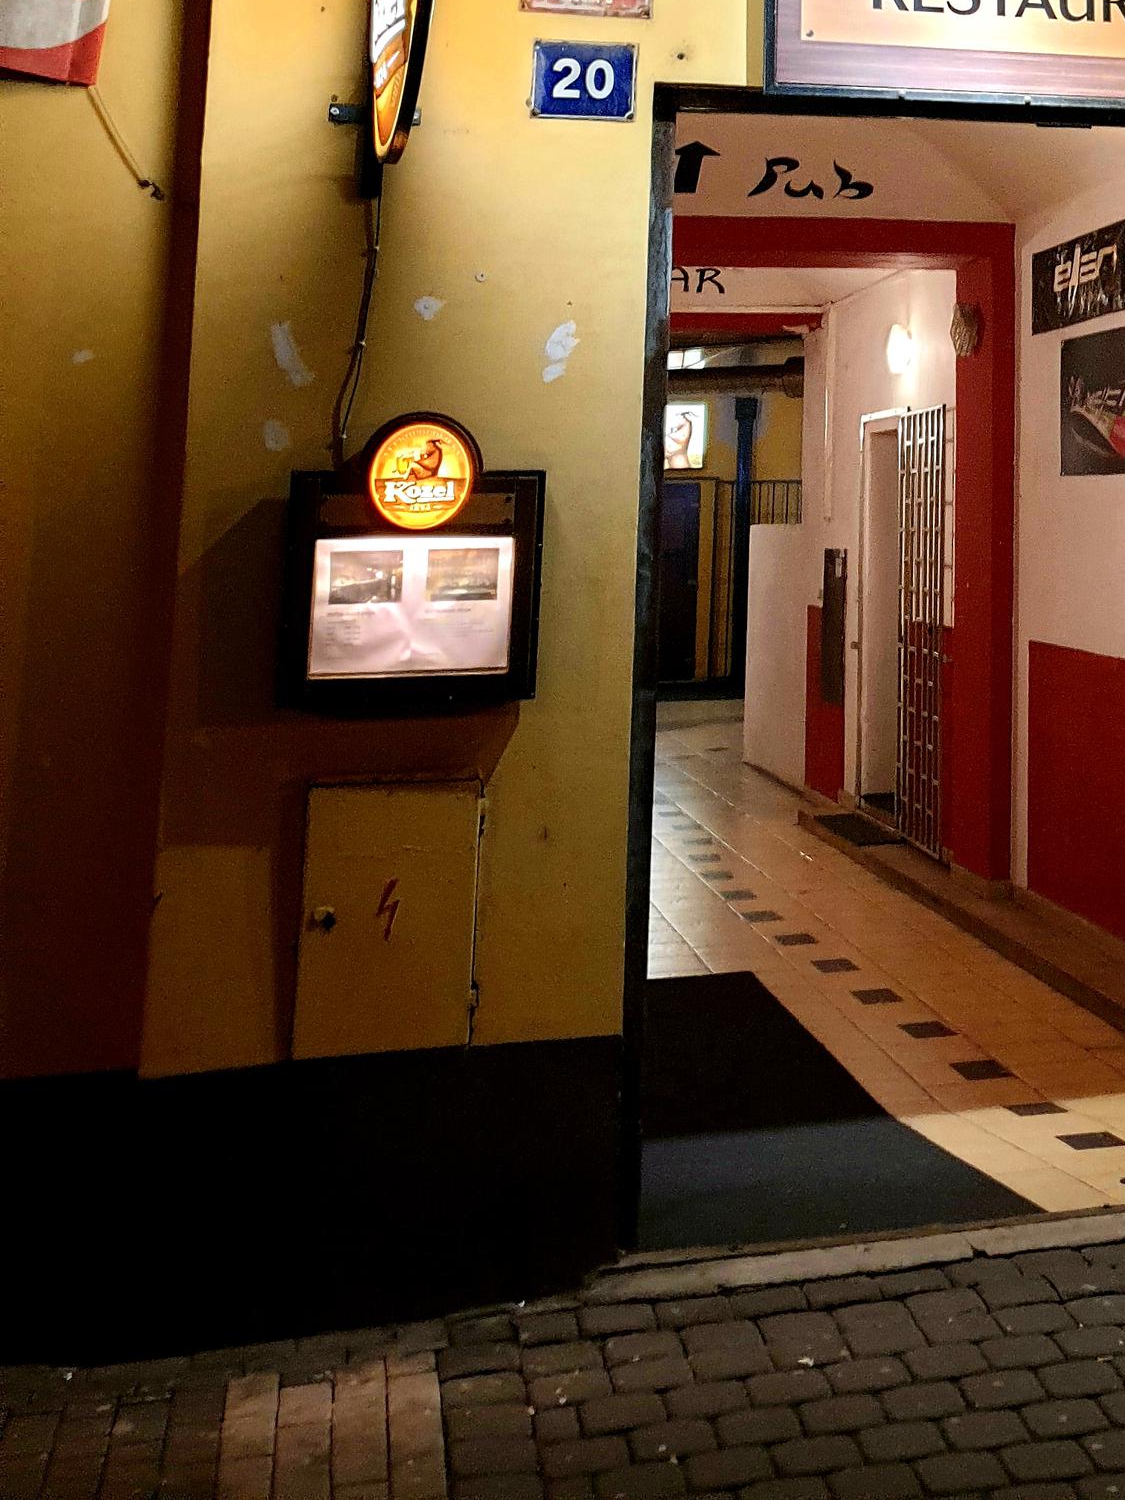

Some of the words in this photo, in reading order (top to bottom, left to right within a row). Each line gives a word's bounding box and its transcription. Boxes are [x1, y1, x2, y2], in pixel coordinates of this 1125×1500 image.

[552, 57, 616, 100] 20
[747, 156, 874, 200] Pub
[1053, 243, 1118, 297] elan
[383, 480, 455, 504] Kozel
